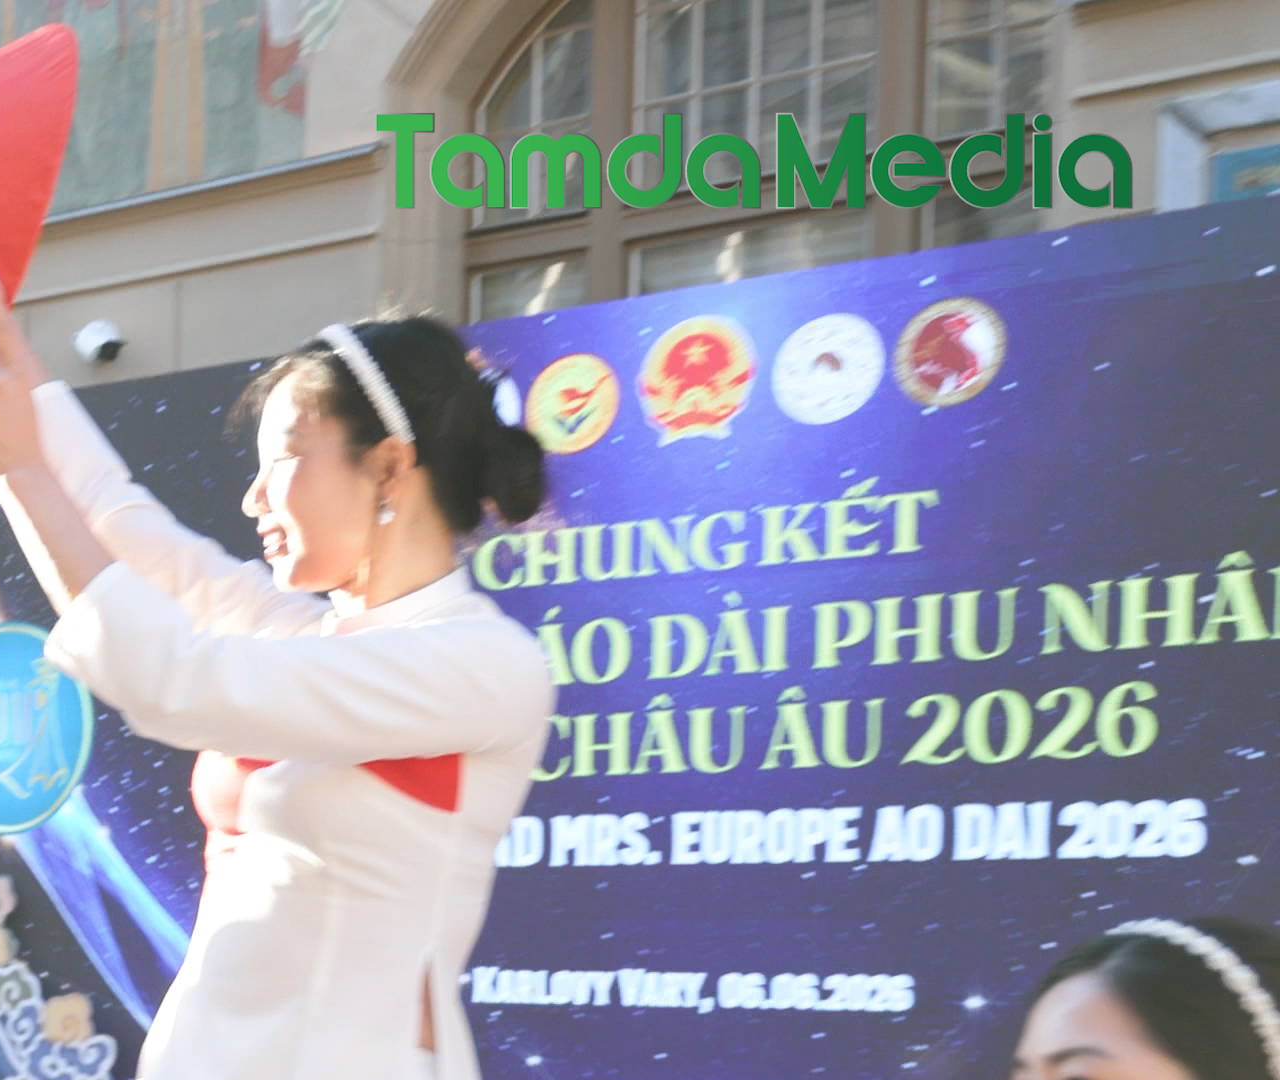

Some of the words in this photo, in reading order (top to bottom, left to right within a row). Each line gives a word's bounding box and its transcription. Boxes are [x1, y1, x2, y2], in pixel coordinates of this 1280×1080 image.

[473, 509, 749, 592] CHUNG
[755, 476, 940, 567] KẾT
[646, 591, 792, 680] DÀI
[1038, 550, 1280, 656] NHÂ
[758, 685, 887, 771] ÂU
[901, 681, 1160, 764] 2026
[548, 812, 662, 868] MRS.
[670, 806, 863, 866] EUROPE
[866, 803, 945, 863] AO
[951, 801, 1053, 861] DAI
[1056, 798, 1209, 859] 2026
